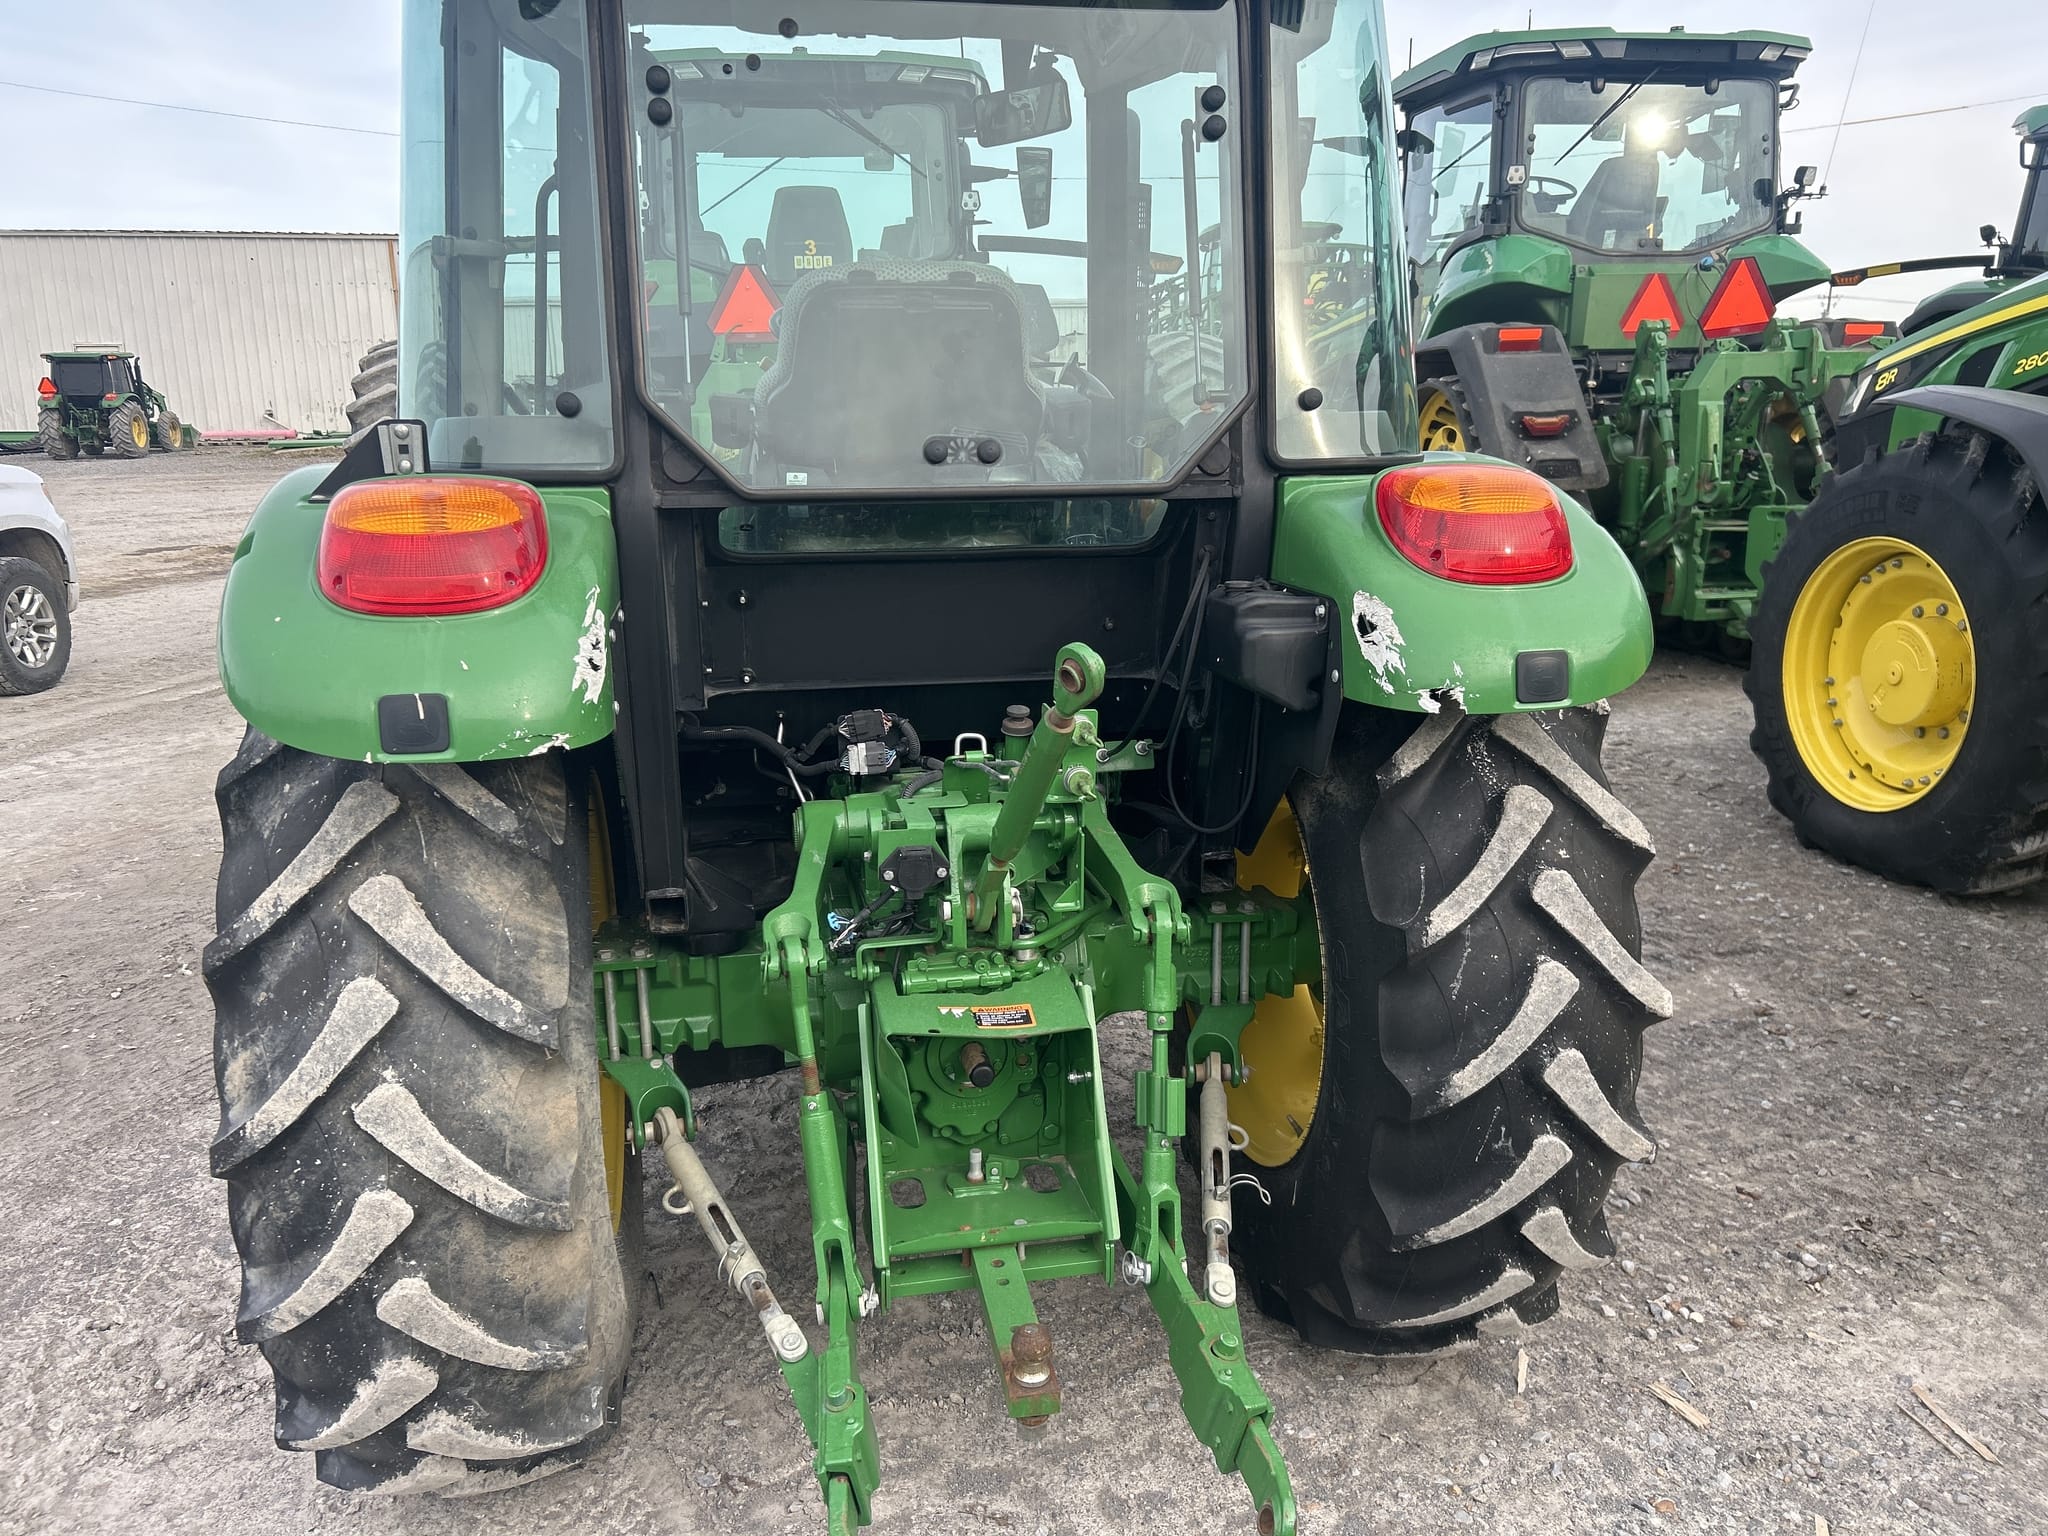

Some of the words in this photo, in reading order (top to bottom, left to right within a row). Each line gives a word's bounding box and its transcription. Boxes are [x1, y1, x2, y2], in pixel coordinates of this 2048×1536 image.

[804, 239, 817, 256] 3
[2013, 350, 2048, 375] 280
[1875, 367, 1899, 391] 8R
